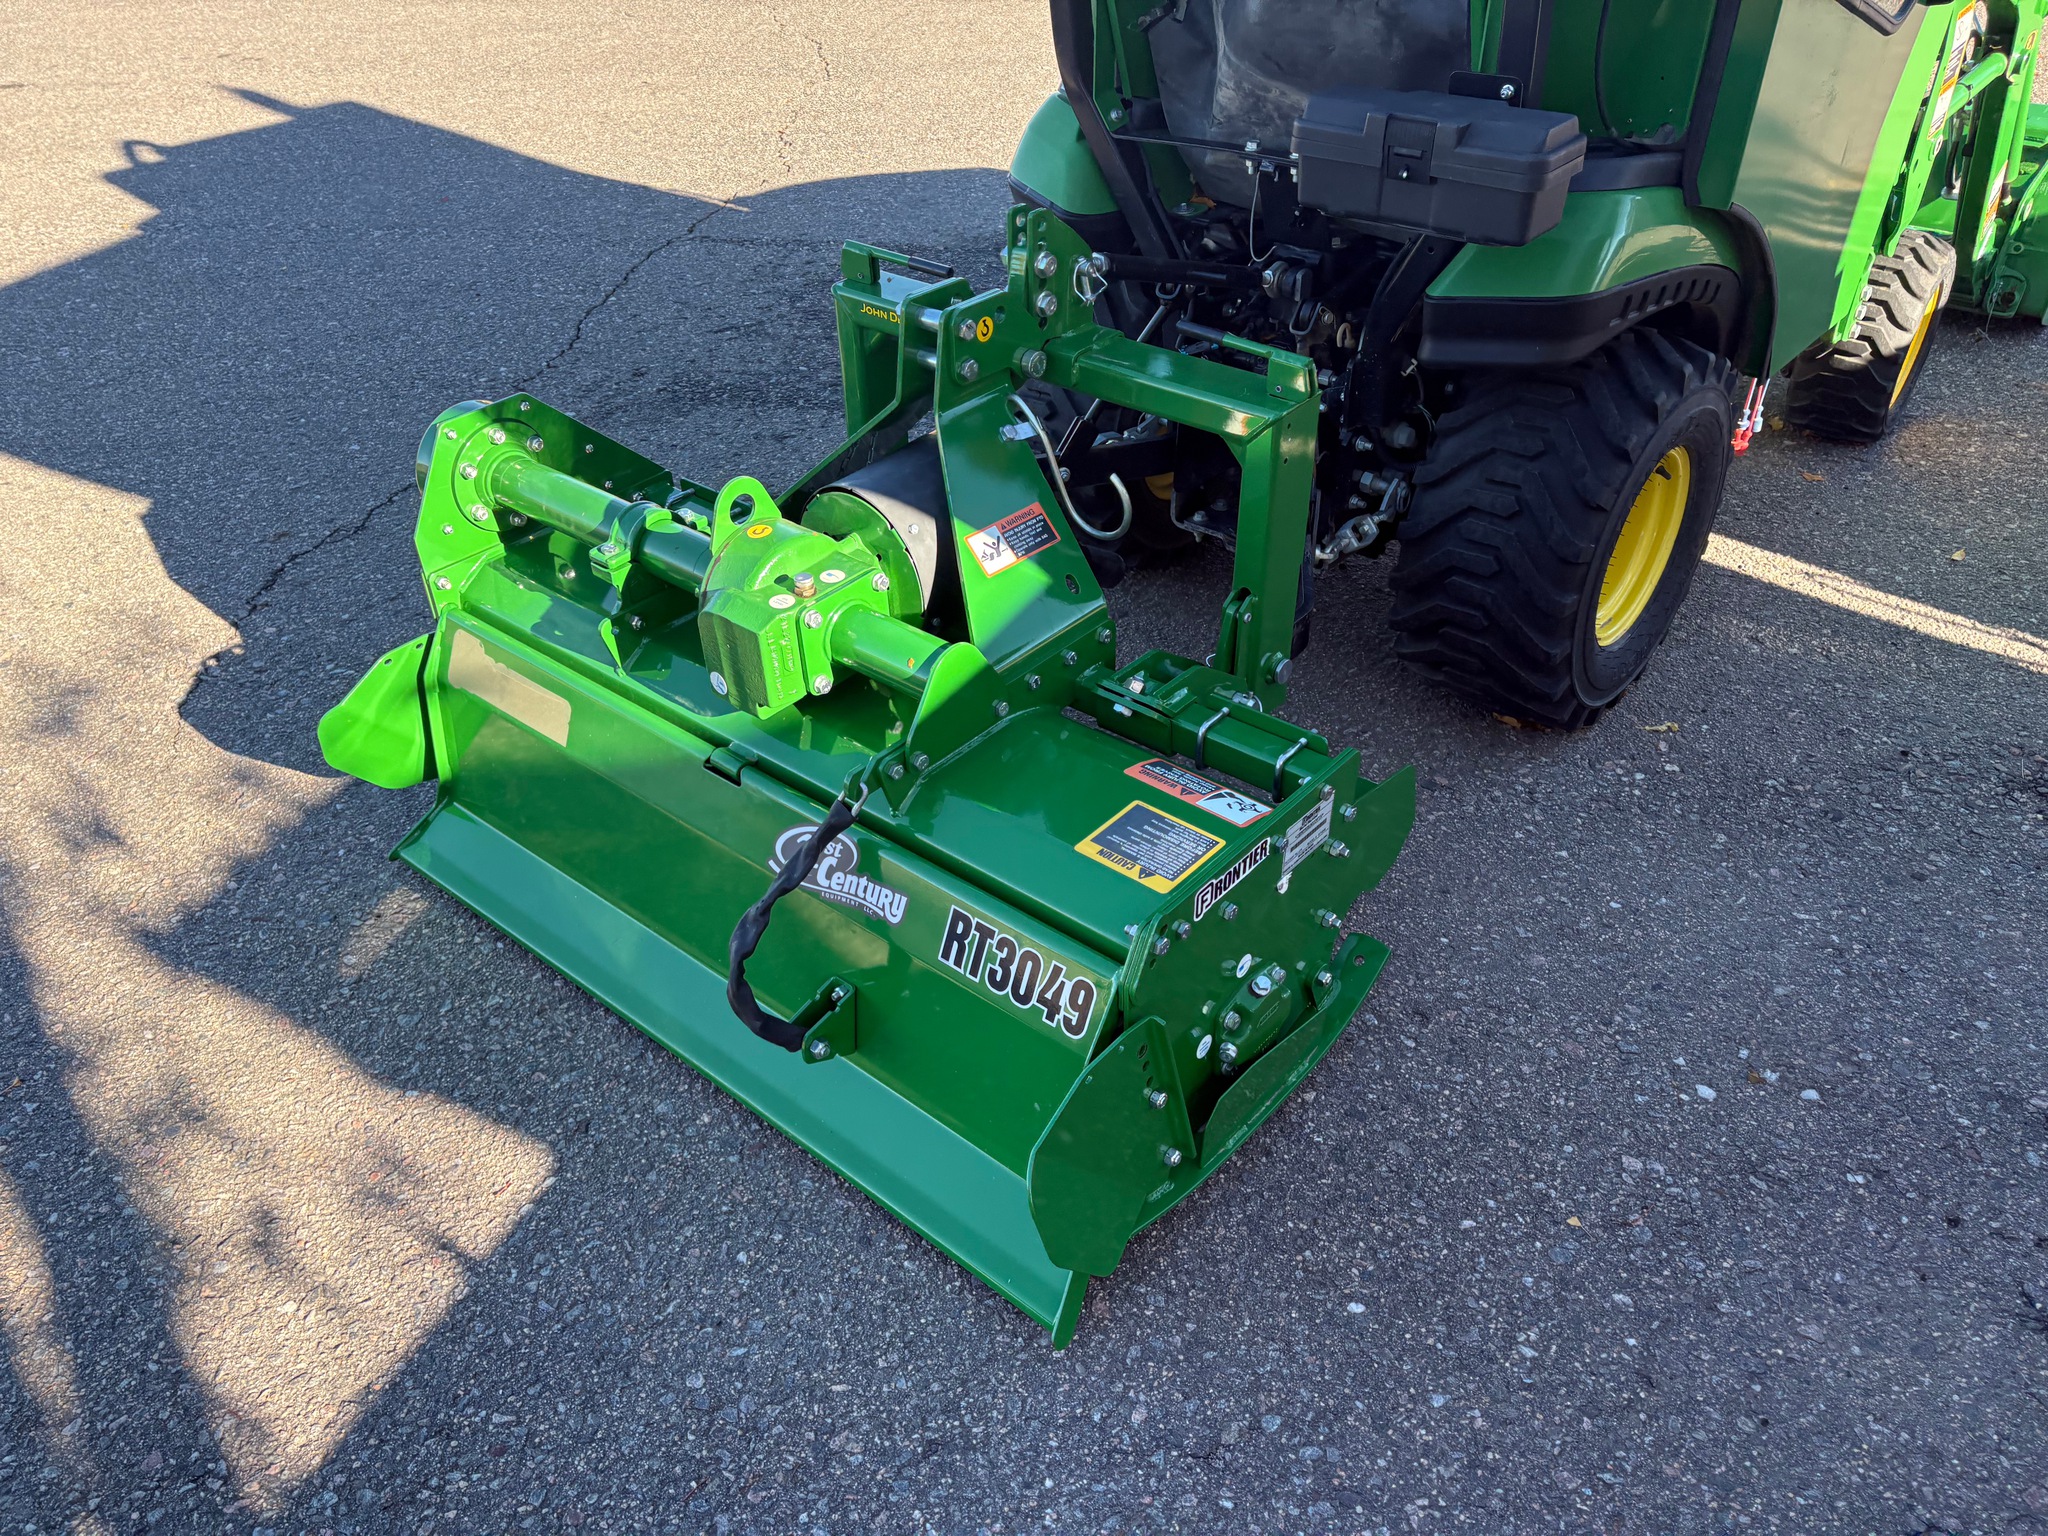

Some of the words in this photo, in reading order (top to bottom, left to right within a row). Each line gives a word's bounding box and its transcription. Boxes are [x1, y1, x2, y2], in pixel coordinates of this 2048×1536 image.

[860, 303, 888, 320] JOHN
[1004, 508, 1036, 527] WARNING
[1139, 769, 1178, 789] WARNING
[1096, 848, 1136, 871] CAUTION
[1194, 838, 1270, 921] FRONTIER
[821, 891, 859, 907] EQUIPMENT
[938, 904, 1097, 1040] RT3049
